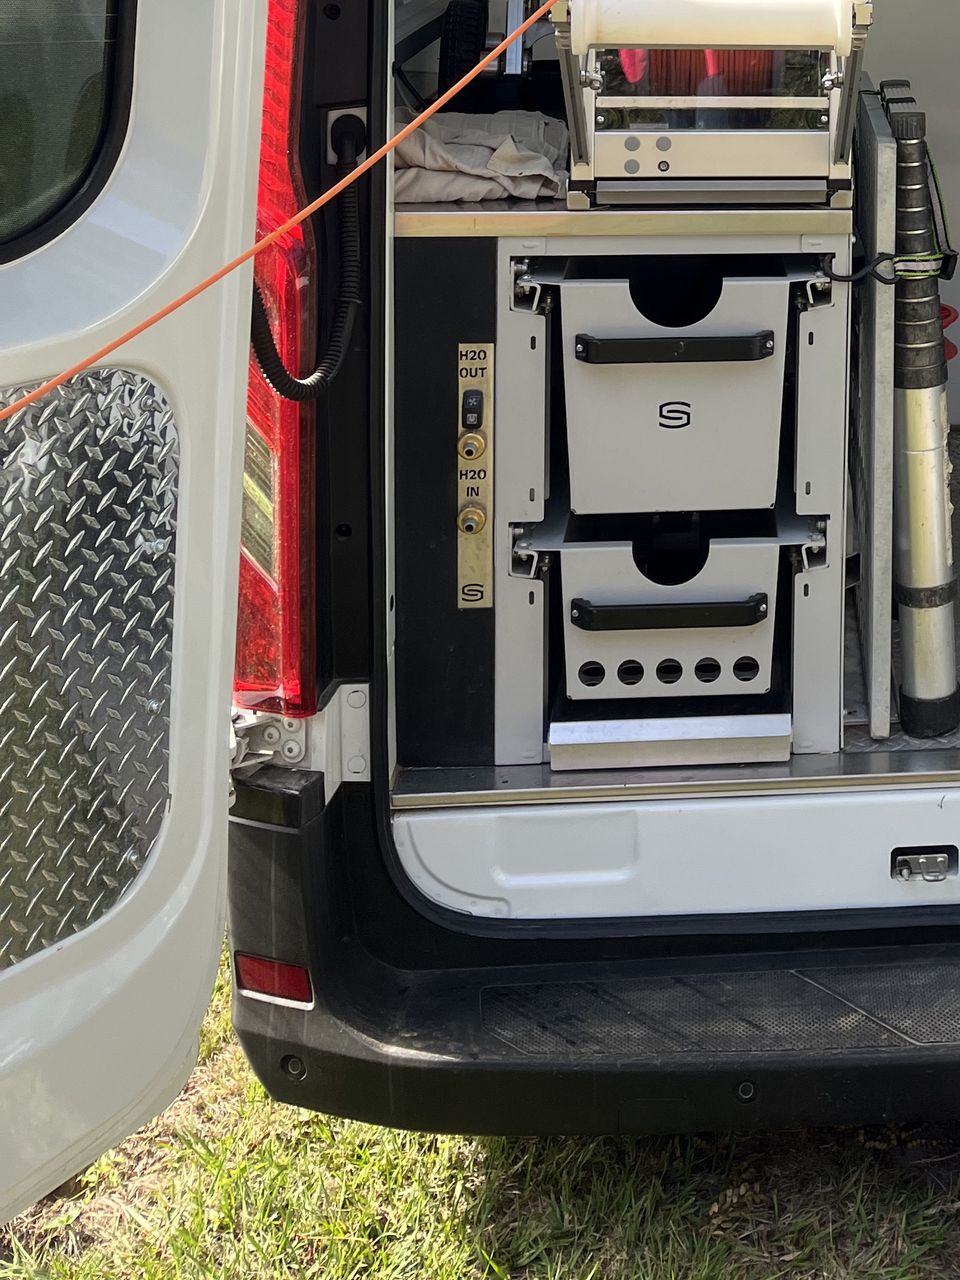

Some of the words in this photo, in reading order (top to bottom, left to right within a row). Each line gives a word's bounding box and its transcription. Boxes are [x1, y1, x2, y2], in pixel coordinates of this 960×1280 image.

[460, 349, 487, 361] H2O
[460, 367, 487, 379] OUT
[459, 469, 487, 480] H2O
[466, 486, 480, 497] IN
